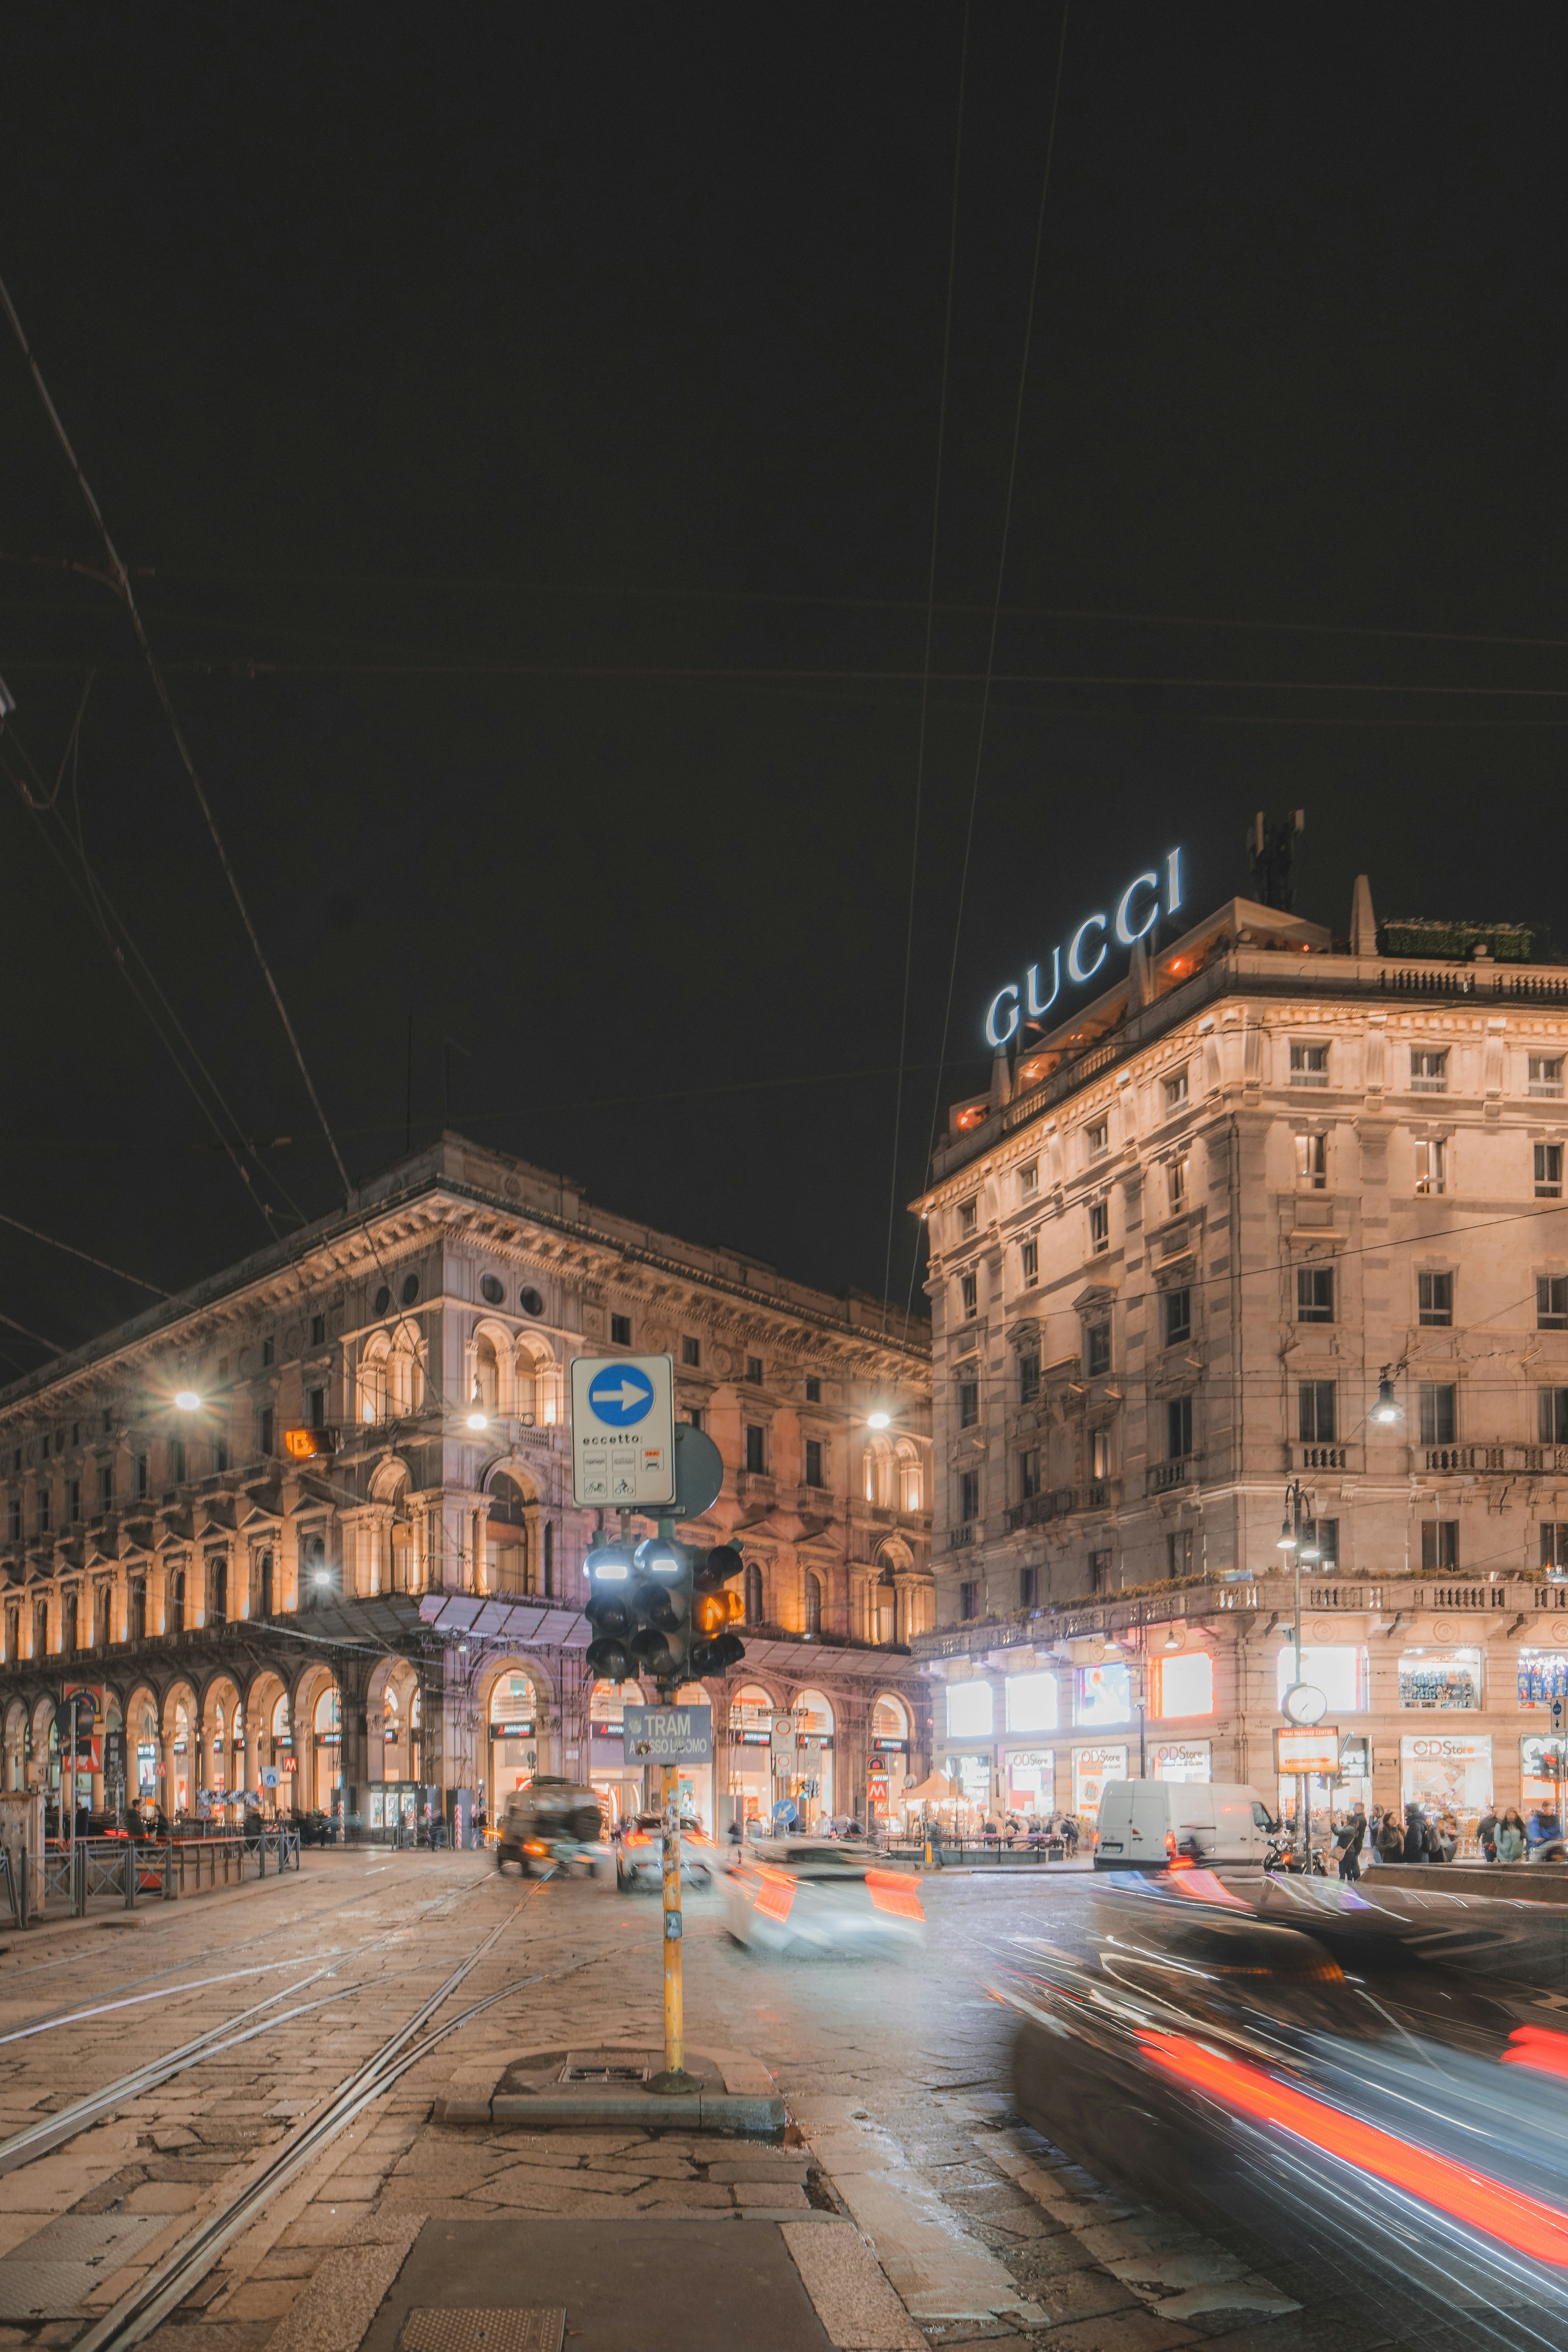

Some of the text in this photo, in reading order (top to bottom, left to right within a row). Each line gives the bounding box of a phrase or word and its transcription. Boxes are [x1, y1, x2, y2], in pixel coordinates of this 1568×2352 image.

[985, 847, 1181, 1047] GUCCI
[644, 1714, 691, 1737] TRAM
[1159, 1746, 1203, 1761] ODStore
[1413, 1740, 1475, 1756] ODStore
[1014, 1754, 1048, 1766] ODStore
[1082, 1750, 1120, 1763] ODStore
[869, 1784, 885, 1797] M
